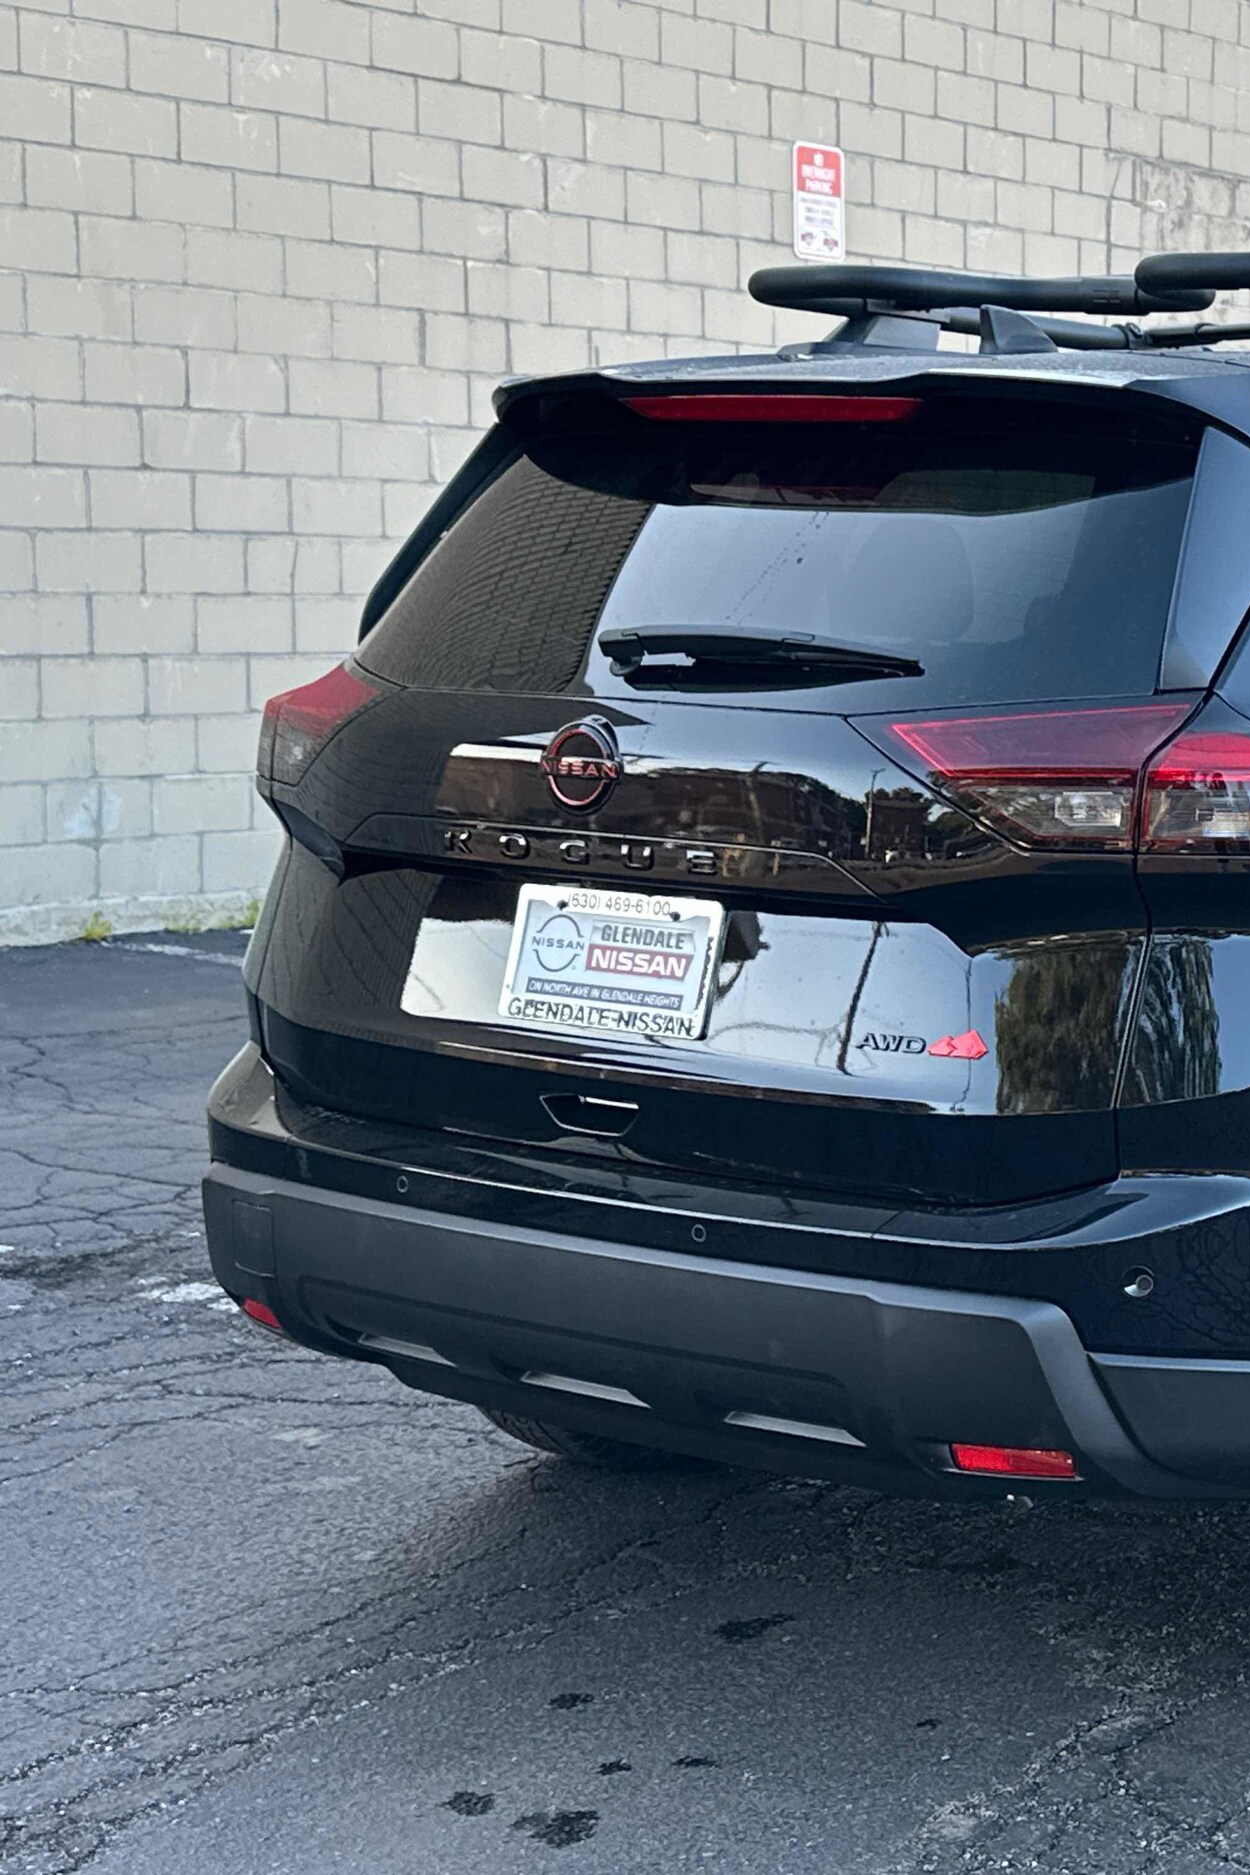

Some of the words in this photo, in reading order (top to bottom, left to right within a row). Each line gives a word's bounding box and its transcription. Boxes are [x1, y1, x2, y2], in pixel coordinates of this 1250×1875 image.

[540, 760, 616, 778] NISSAN
[444, 829, 718, 875] ROGUE
[531, 935, 585, 951] NISSAN
[600, 924, 686, 950] GLENDALE
[590, 948, 687, 978] NISSAN
[528, 980, 542, 991] ON
[542, 981, 571, 995] NORTH
[572, 986, 590, 998] AVE
[590, 989, 601, 999] IN
[601, 988, 642, 1004] GLENDALE
[643, 994, 681, 1009] HEIGHTS
[855, 1032, 927, 1054] AWD
